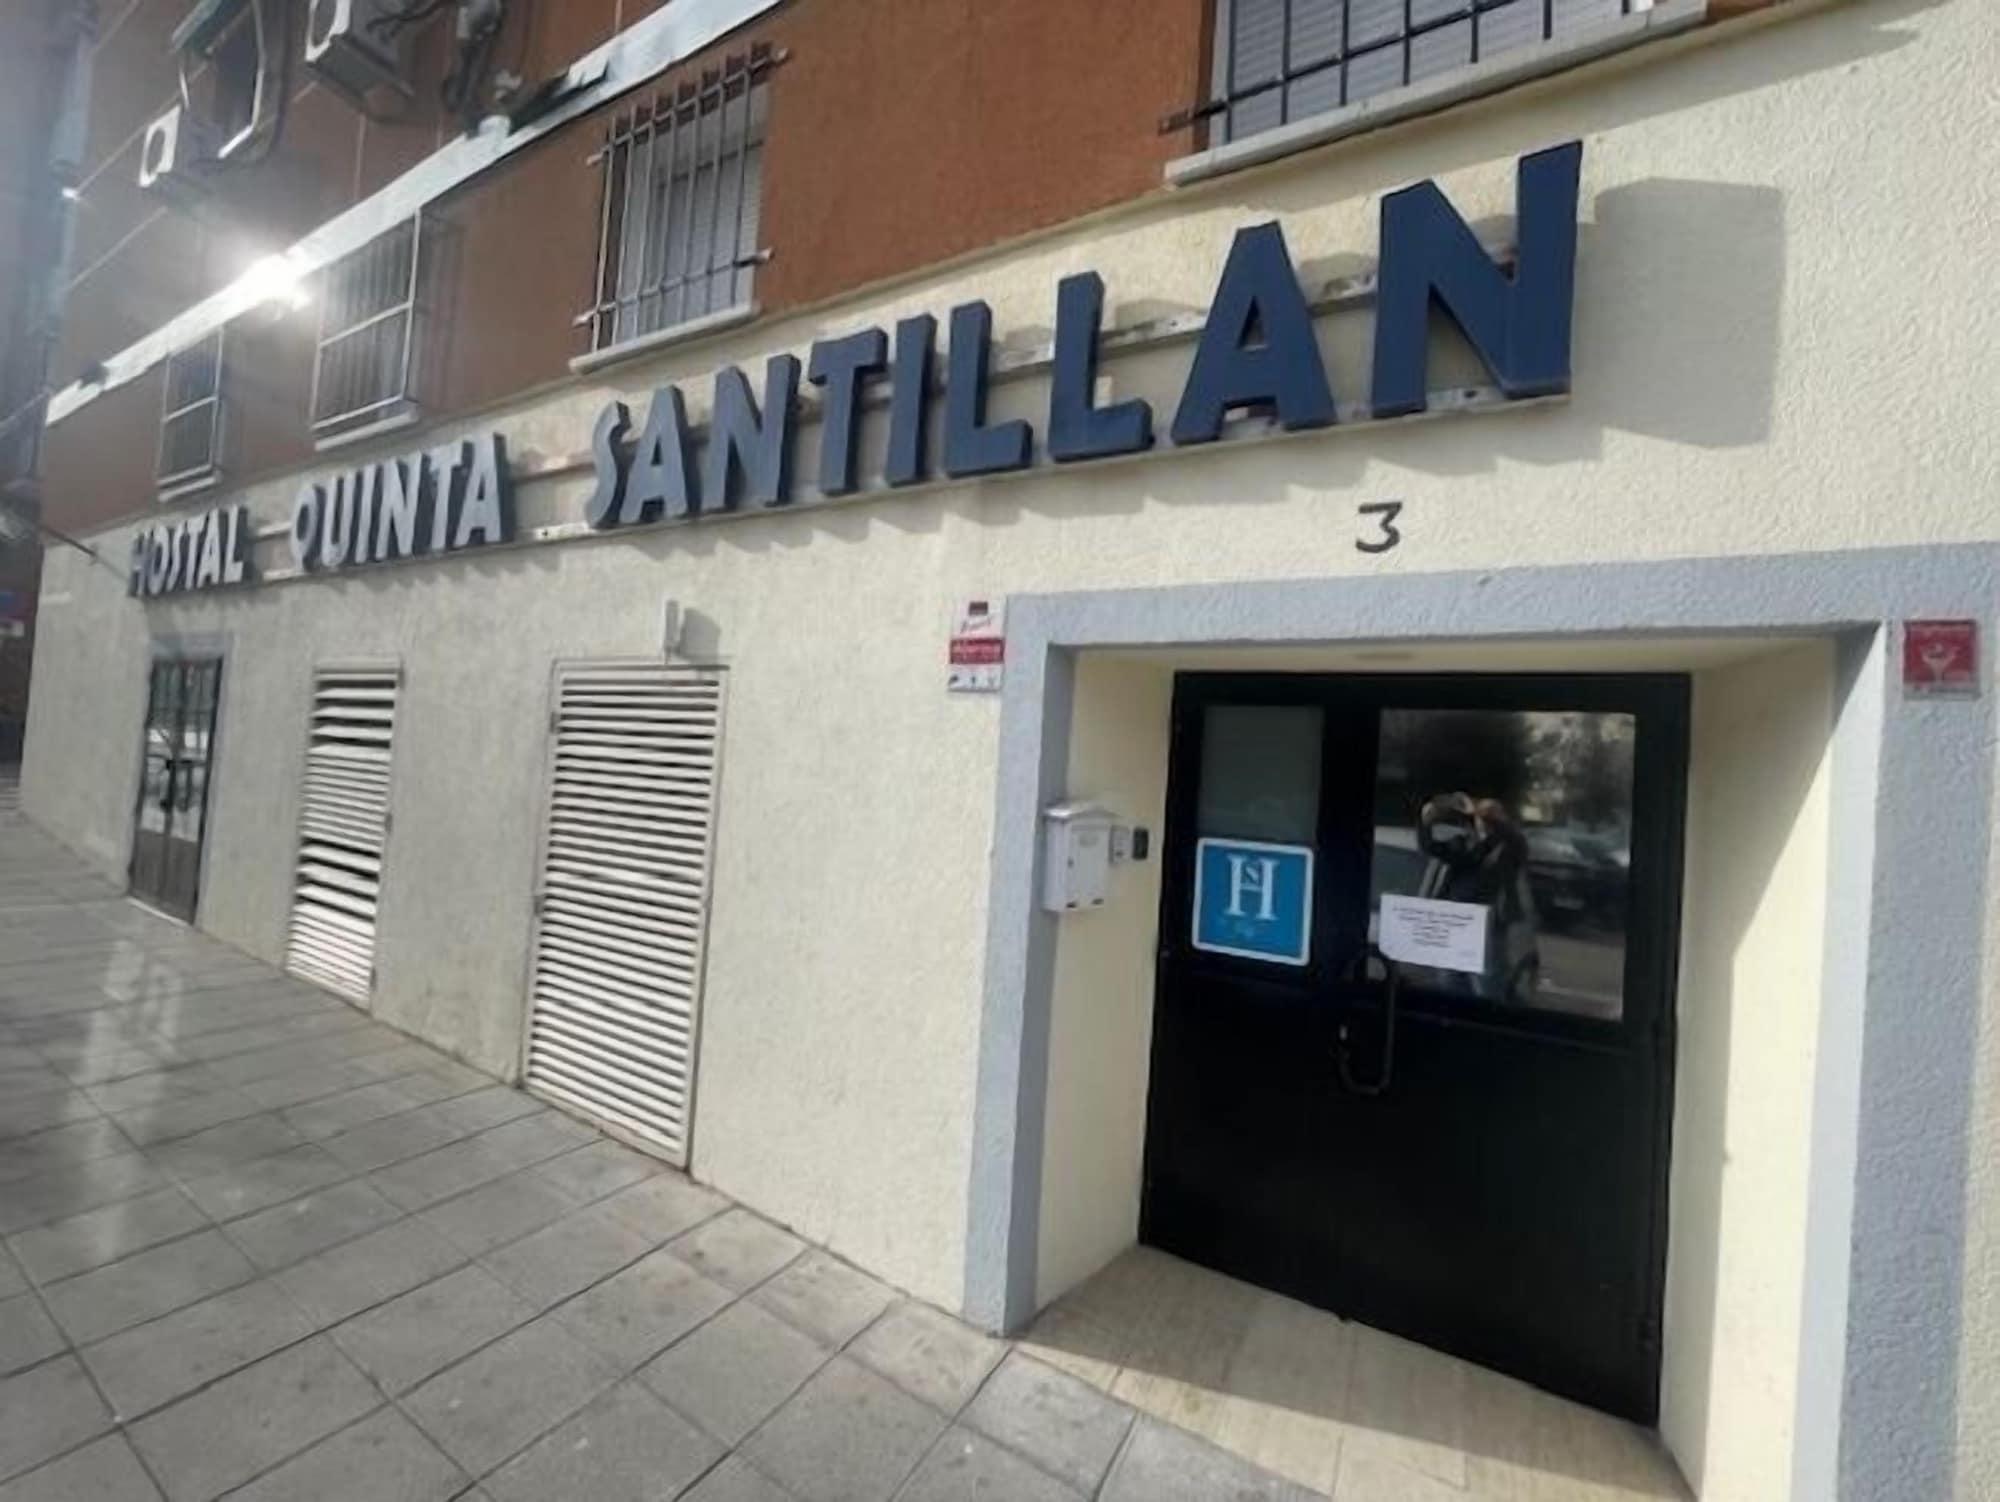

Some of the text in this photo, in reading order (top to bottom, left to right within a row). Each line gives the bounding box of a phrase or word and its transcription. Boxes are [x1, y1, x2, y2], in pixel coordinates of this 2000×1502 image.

[129, 140, 1582, 598] HOSTAL QUINTA SANTILLAN
[1356, 501, 1403, 554] 3
